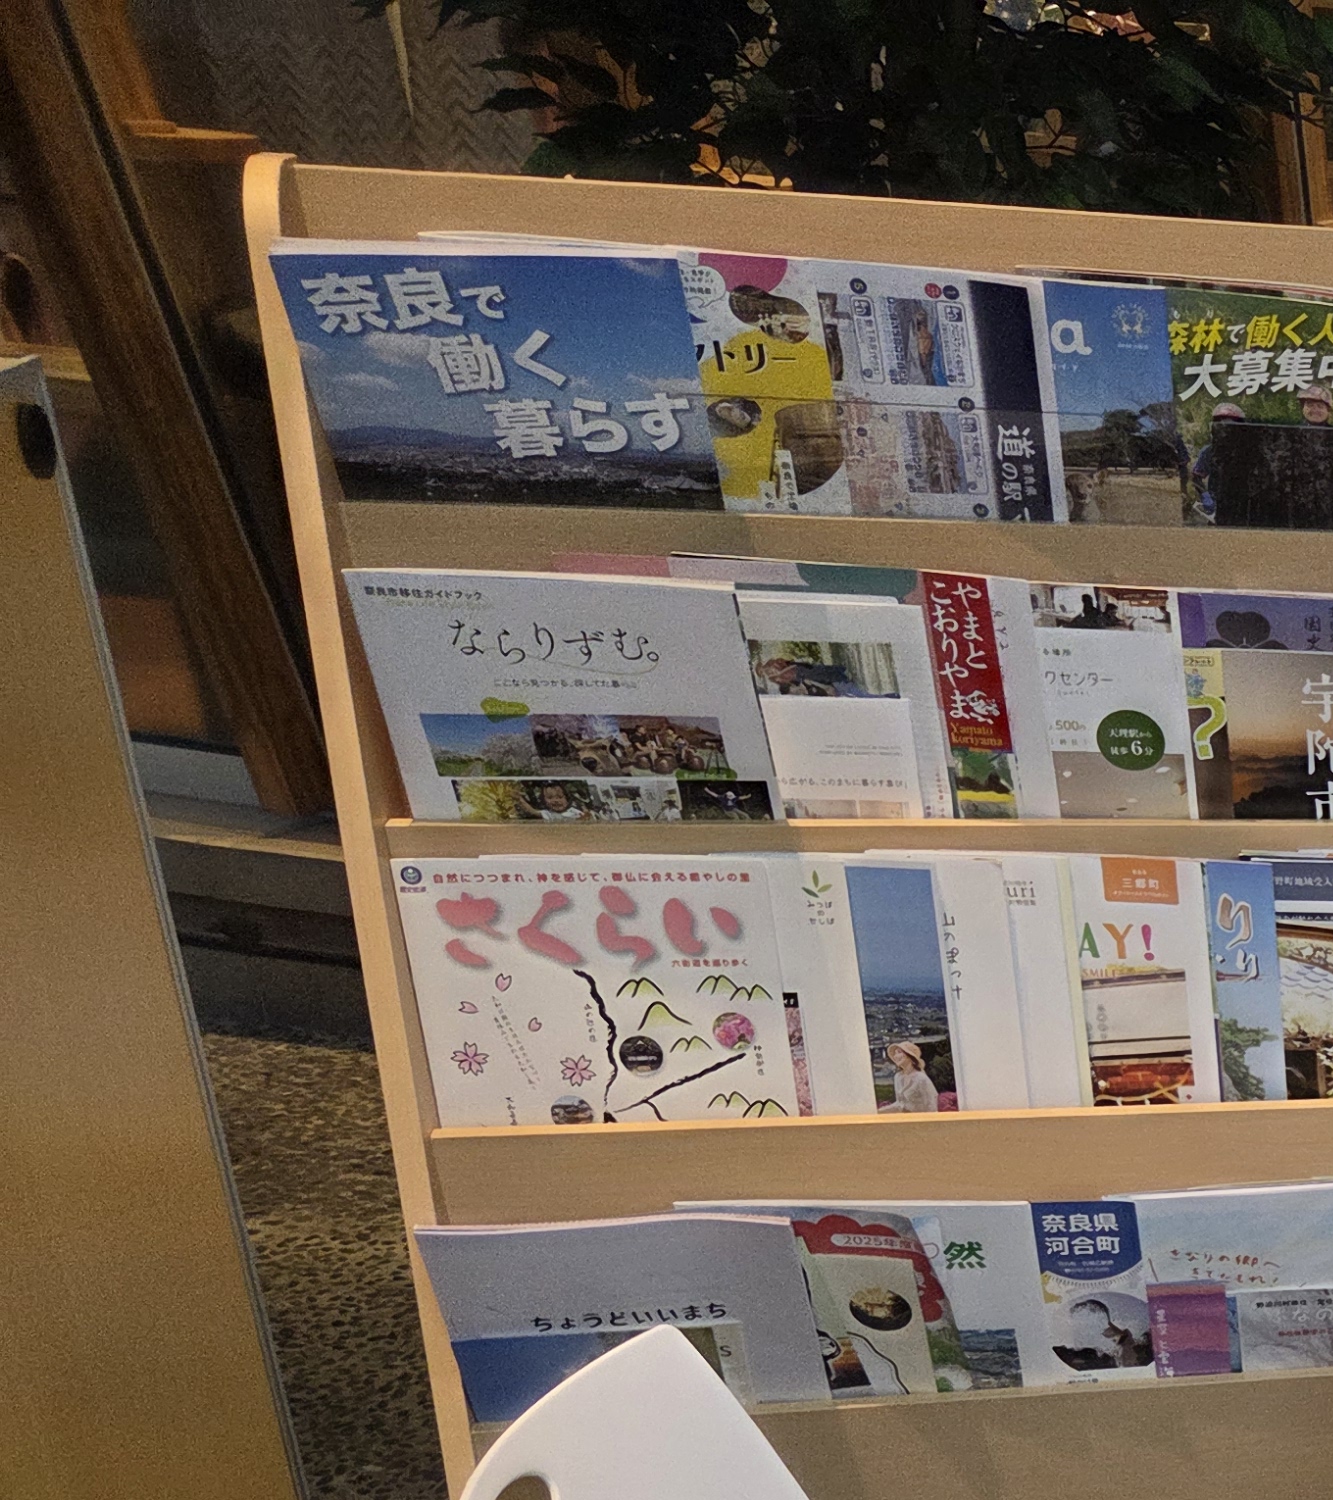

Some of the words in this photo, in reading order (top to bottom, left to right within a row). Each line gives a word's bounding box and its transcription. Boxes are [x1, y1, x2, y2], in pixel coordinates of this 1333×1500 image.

[302, 267, 506, 334] 奈良で
[427, 328, 567, 394] 働く
[484, 392, 690, 459] 暮らす
[997, 424, 1036, 501] 道の駅
[449, 620, 659, 665] ならりずむ。
[930, 582, 969, 719] こおりやま
[952, 582, 987, 670] やまと
[1110, 740, 1154, 756] 徒歩6分
[436, 886, 741, 970] さくらい
[1079, 921, 1156, 962] AY!
[1042, 1213, 1119, 1233] 奈良県
[1044, 1236, 1120, 1256] 河合町
[943, 1241, 986, 1270] 然
[531, 1302, 726, 1332] ちょうどいいまち
